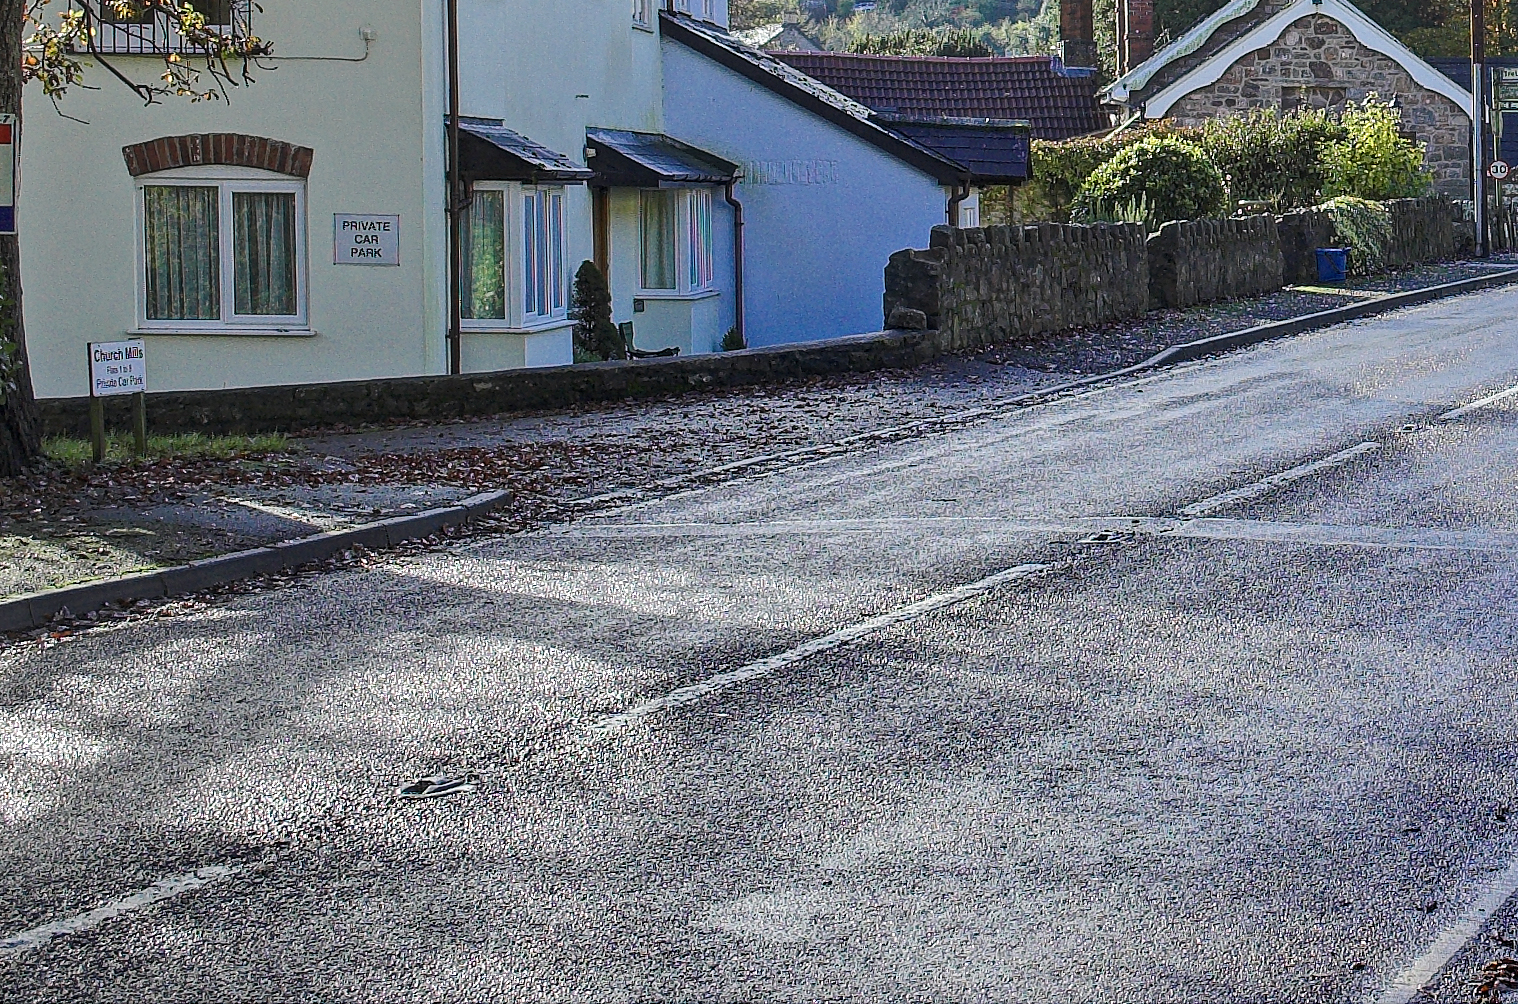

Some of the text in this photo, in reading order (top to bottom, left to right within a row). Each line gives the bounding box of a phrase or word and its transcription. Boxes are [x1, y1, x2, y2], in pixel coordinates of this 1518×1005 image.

[1491, 165, 1506, 174] 30
[342, 220, 391, 231] PRIVATE
[354, 234, 379, 244] CAR
[350, 247, 382, 258] PARK
[94, 346, 144, 362] Church Mills
[96, 375, 144, 389] Private Car Park
